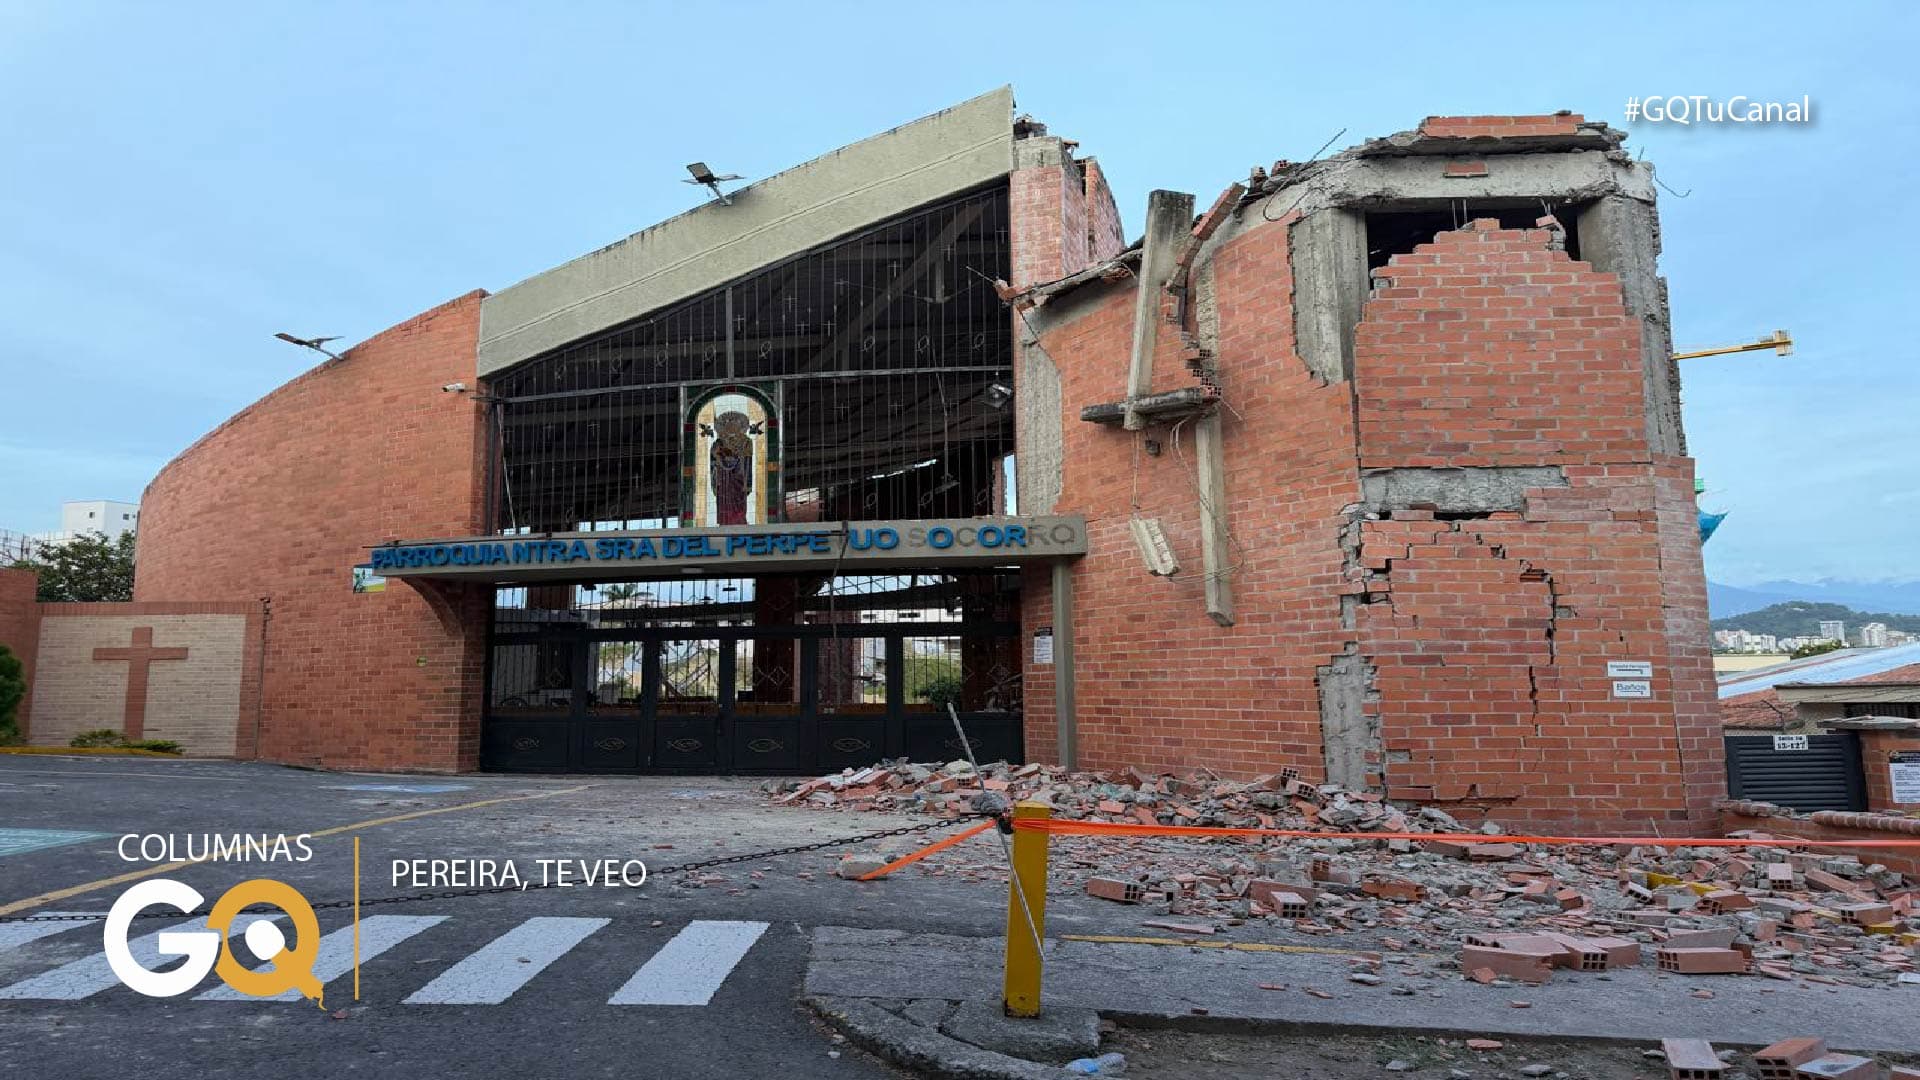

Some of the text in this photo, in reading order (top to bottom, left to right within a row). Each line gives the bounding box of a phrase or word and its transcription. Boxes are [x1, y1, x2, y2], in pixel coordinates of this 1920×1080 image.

[371, 543, 509, 570] PARROQUIA
[511, 537, 591, 565] NTRA
[594, 536, 657, 562] SRA
[661, 534, 721, 558] DEL
